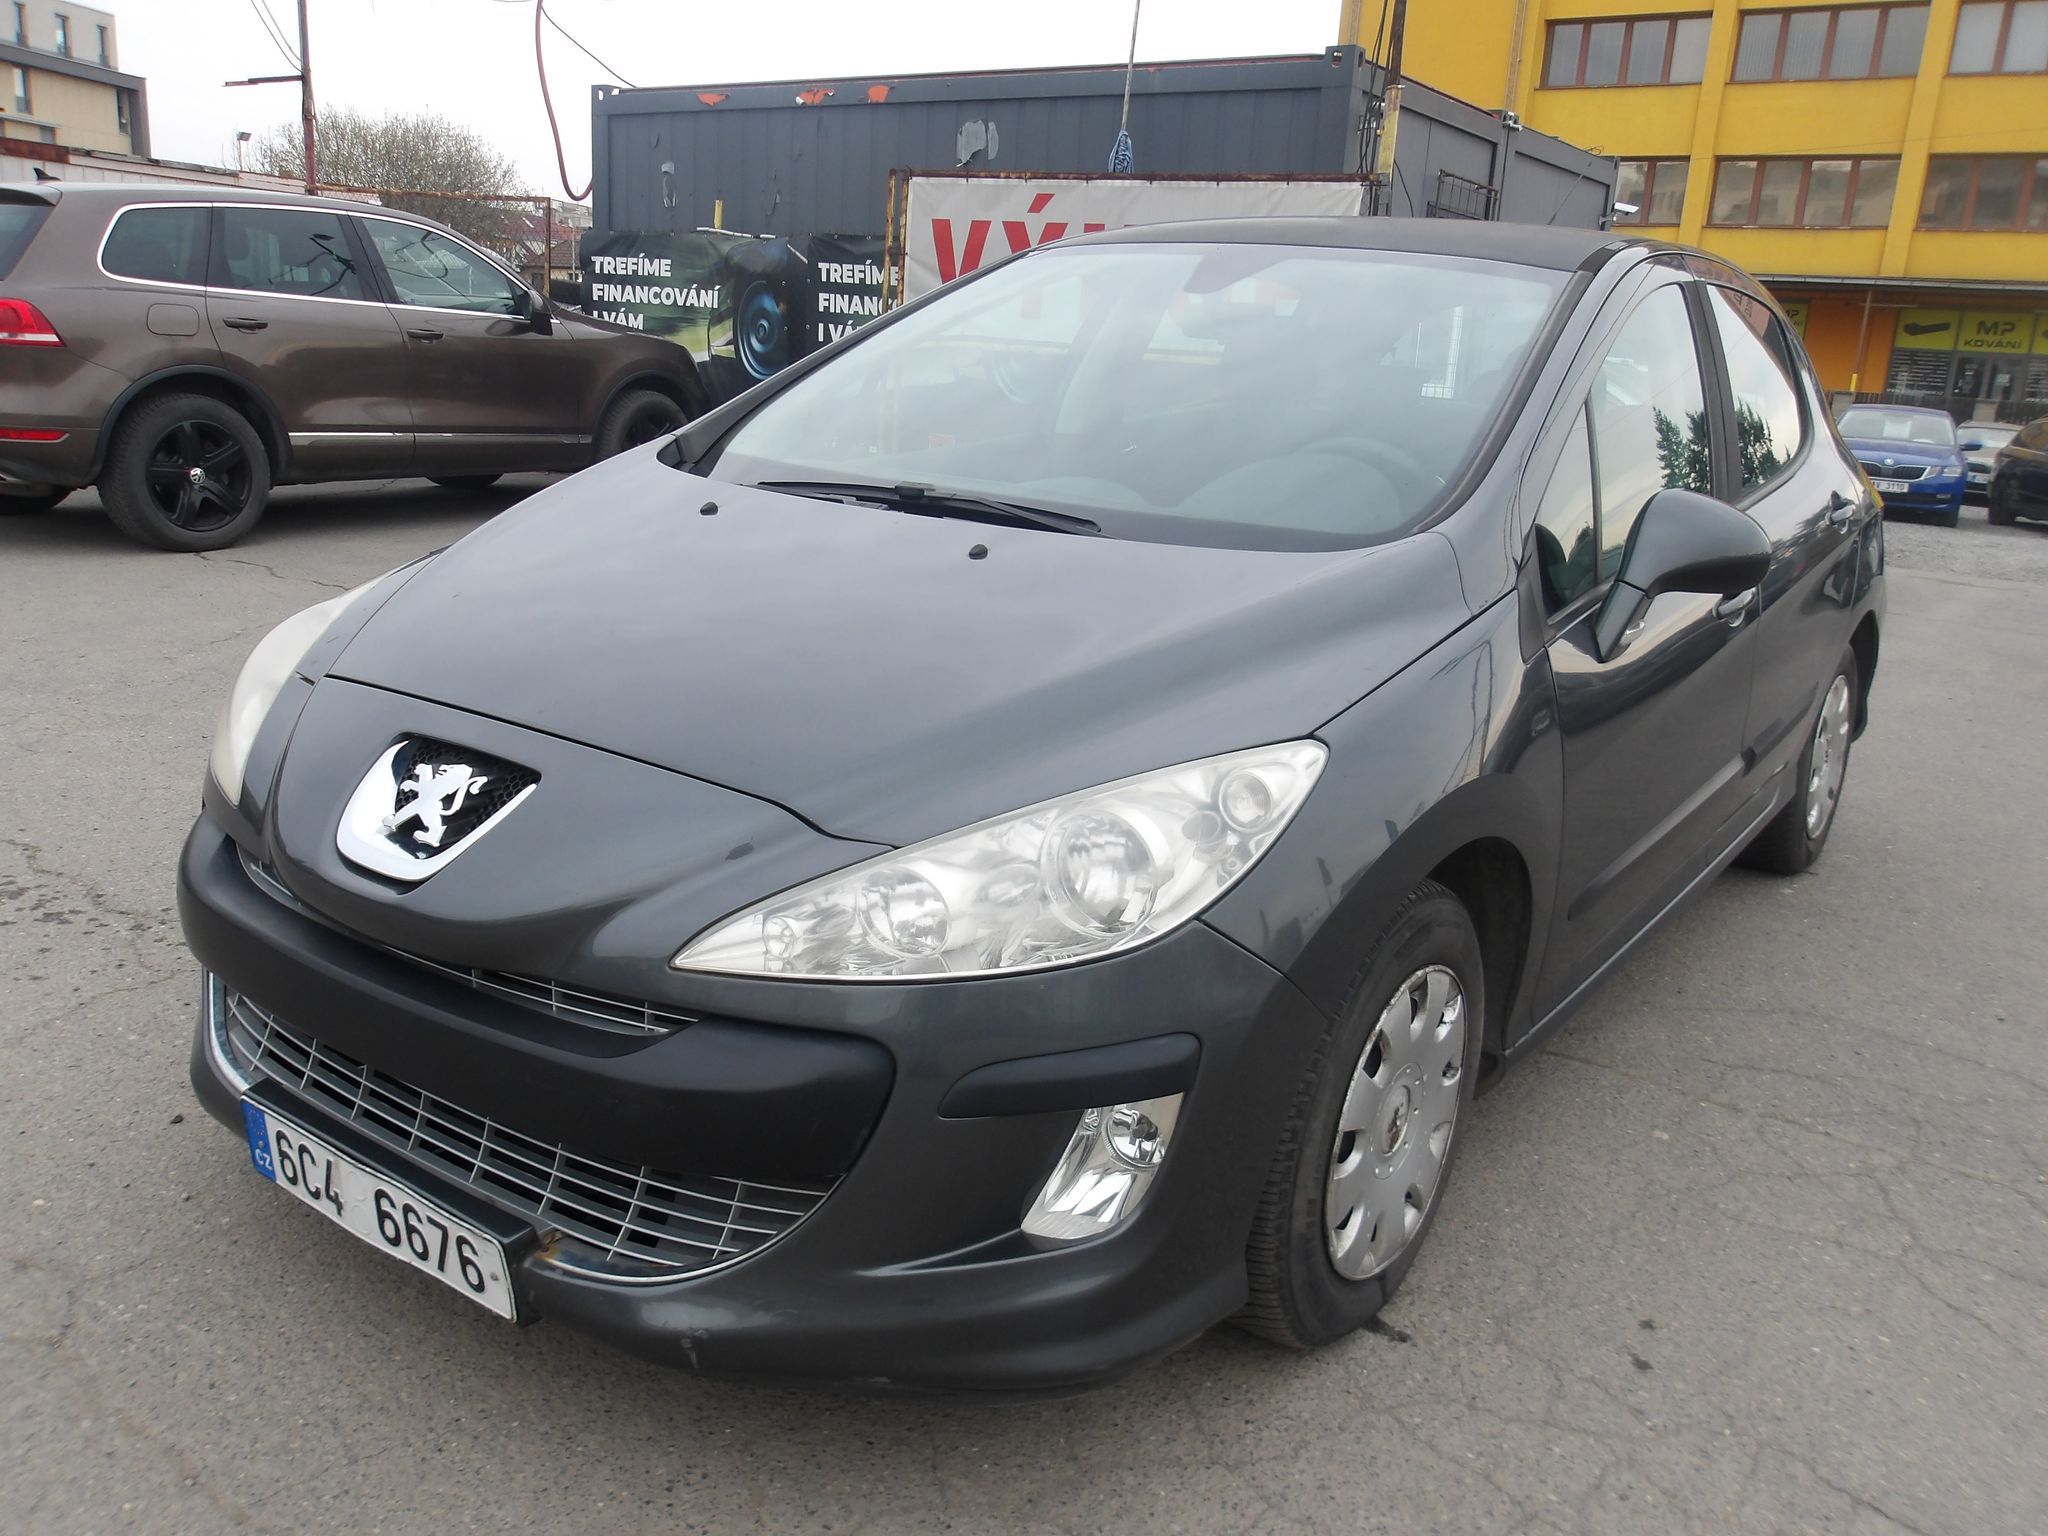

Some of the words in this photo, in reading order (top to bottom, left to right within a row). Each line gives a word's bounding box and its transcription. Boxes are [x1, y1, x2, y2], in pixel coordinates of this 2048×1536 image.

[591, 253, 672, 277] TREFÍME
[592, 283, 721, 309] FINANCOVÁNÍ
[818, 323, 824, 342] I
[828, 320, 861, 342] VÁ
[1976, 321, 2016, 336] MP
[1963, 337, 2022, 349] KOVÁNÍ
[255, 1149, 273, 1170] CZ
[275, 1129, 343, 1217] 6C4
[374, 1188, 485, 1293] 6676
